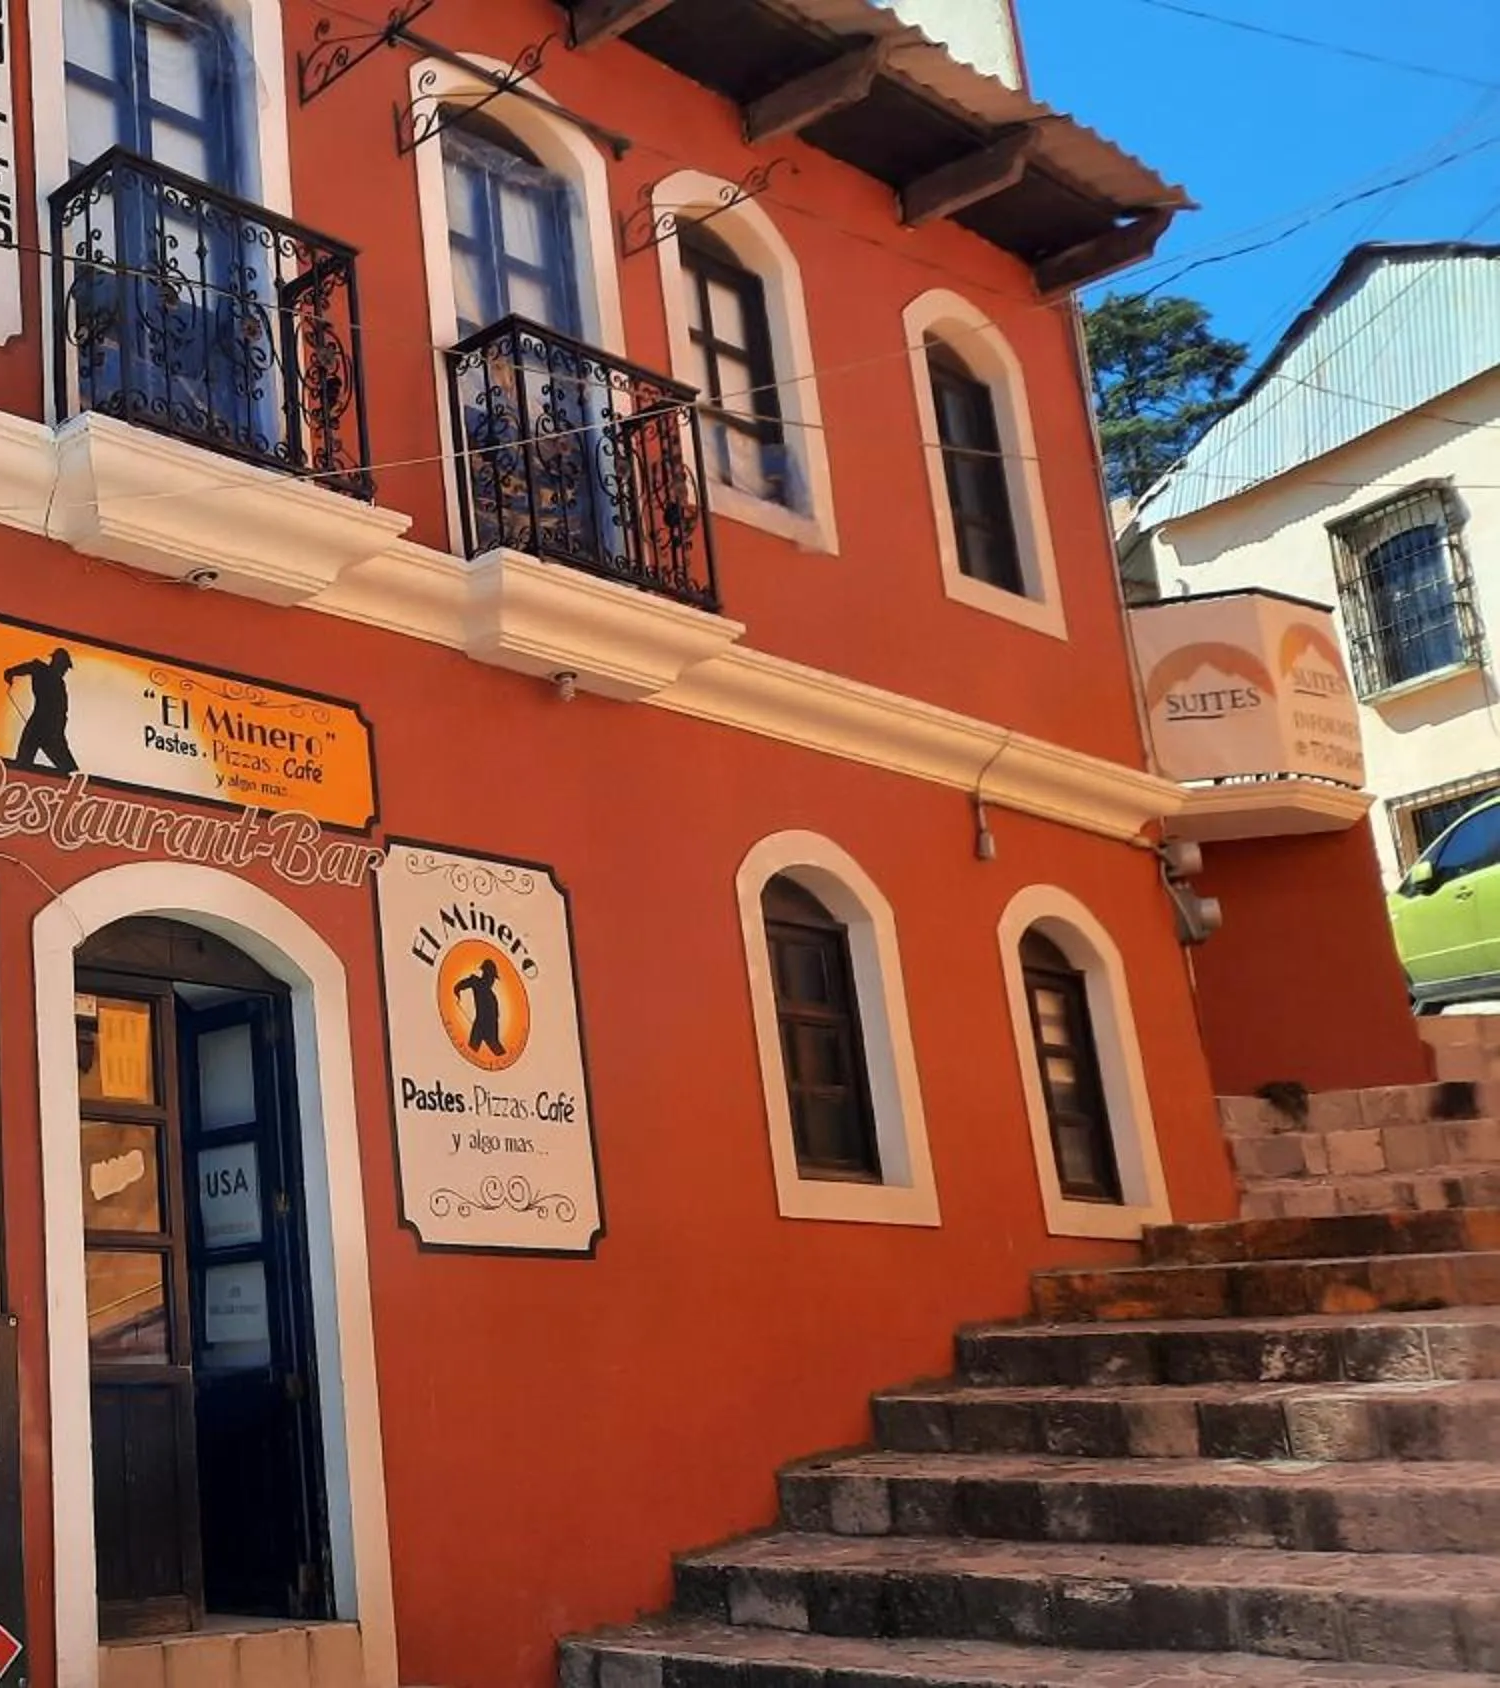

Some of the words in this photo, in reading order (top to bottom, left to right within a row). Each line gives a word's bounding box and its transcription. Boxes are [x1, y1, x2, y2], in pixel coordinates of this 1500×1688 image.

[1167, 687, 1262, 714] SUITES
[215, 773, 225, 789] y
[412, 926, 441, 968] El
[439, 901, 539, 981] Minero
[535, 1091, 576, 1124] Café
[450, 1132, 461, 1155] y
[469, 1129, 501, 1154] algo
[206, 1168, 249, 1199] USA
